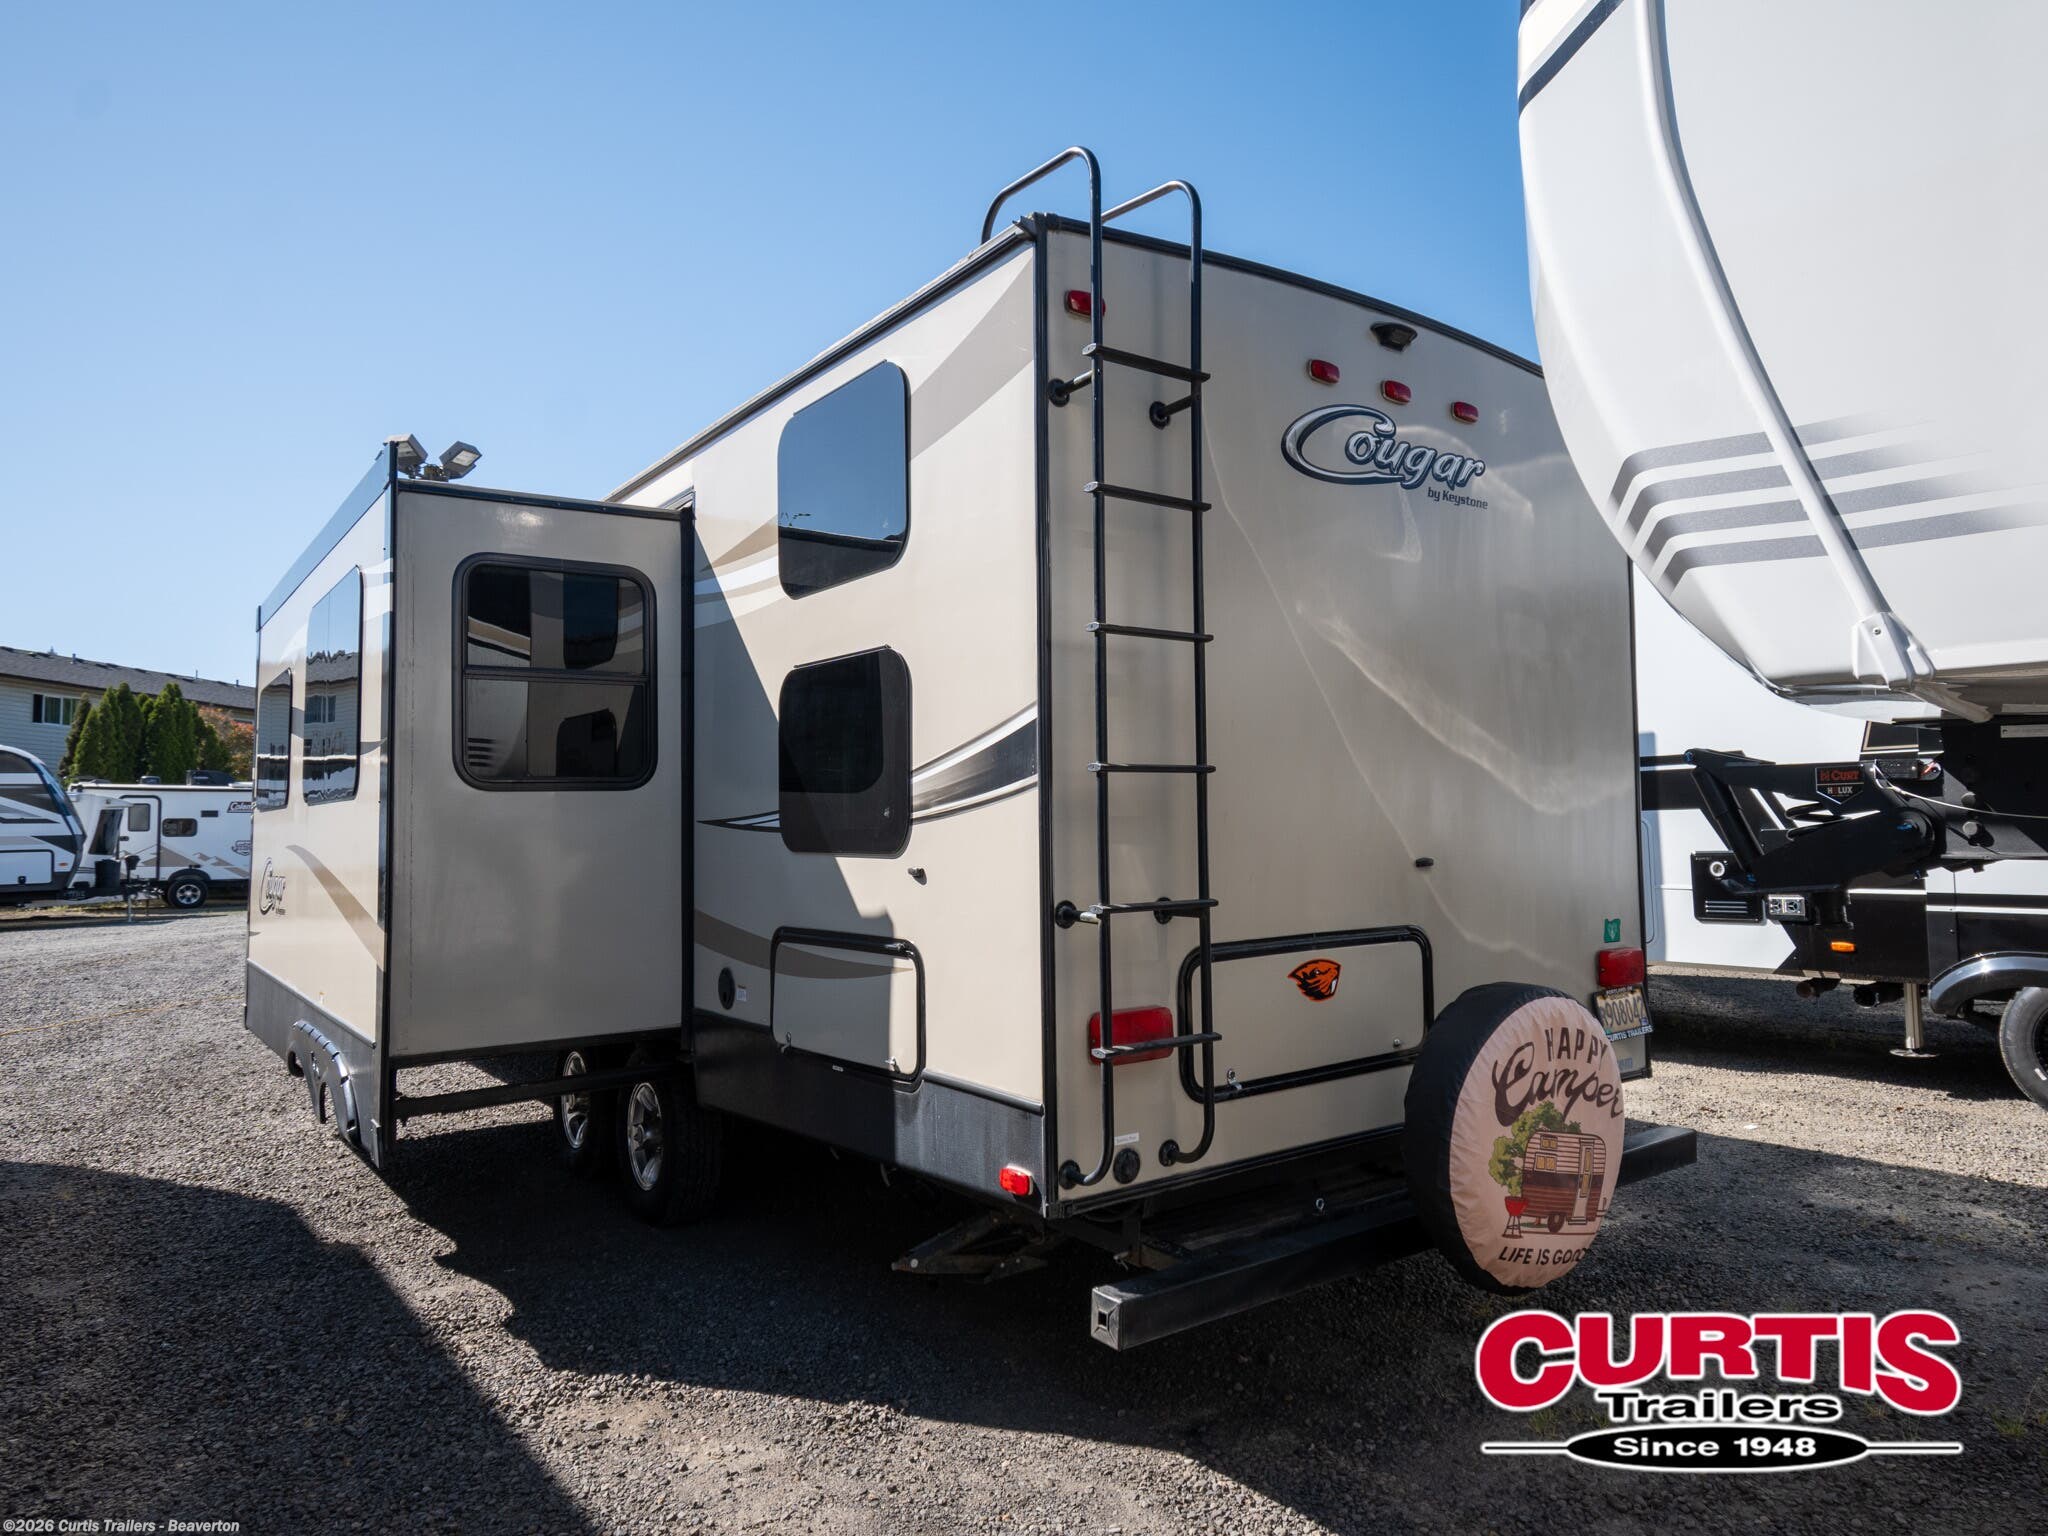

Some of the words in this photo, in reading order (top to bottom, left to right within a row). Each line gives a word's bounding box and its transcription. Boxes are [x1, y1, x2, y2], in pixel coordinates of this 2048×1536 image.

[1281, 404, 1486, 490] Cougar
[1427, 487, 1441, 502] by
[1442, 490, 1488, 510] Keystone
[1628, 1025, 1653, 1037] TRAILERS
[1544, 1026, 1608, 1070] HAPPY
[1492, 1041, 1624, 1127] Camper
[1499, 1246, 1534, 1265] LIFE
[1536, 1248, 1550, 1266] IS
